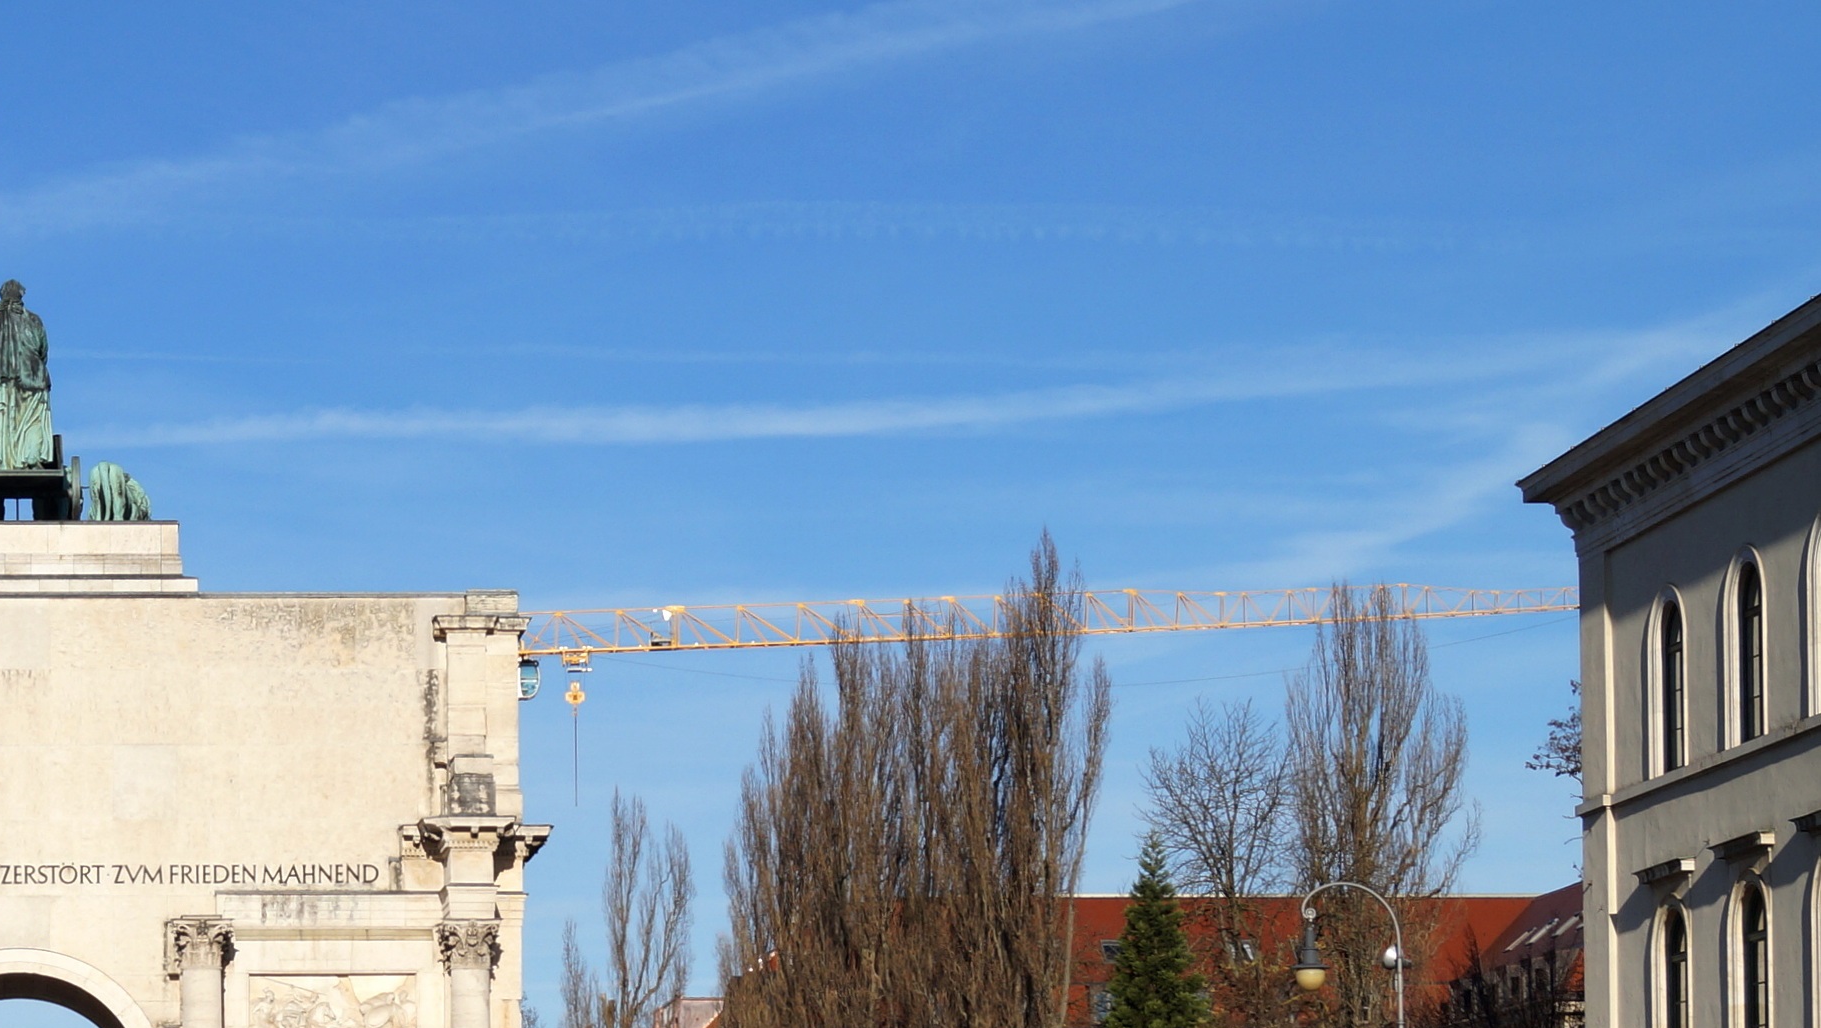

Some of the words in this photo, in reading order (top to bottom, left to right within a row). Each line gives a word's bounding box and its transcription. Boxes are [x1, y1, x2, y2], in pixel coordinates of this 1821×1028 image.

[0, 862, 106, 885] ZERSTÖRT
[169, 864, 257, 885] FRIEDEN
[262, 864, 380, 885] MAHNEND
